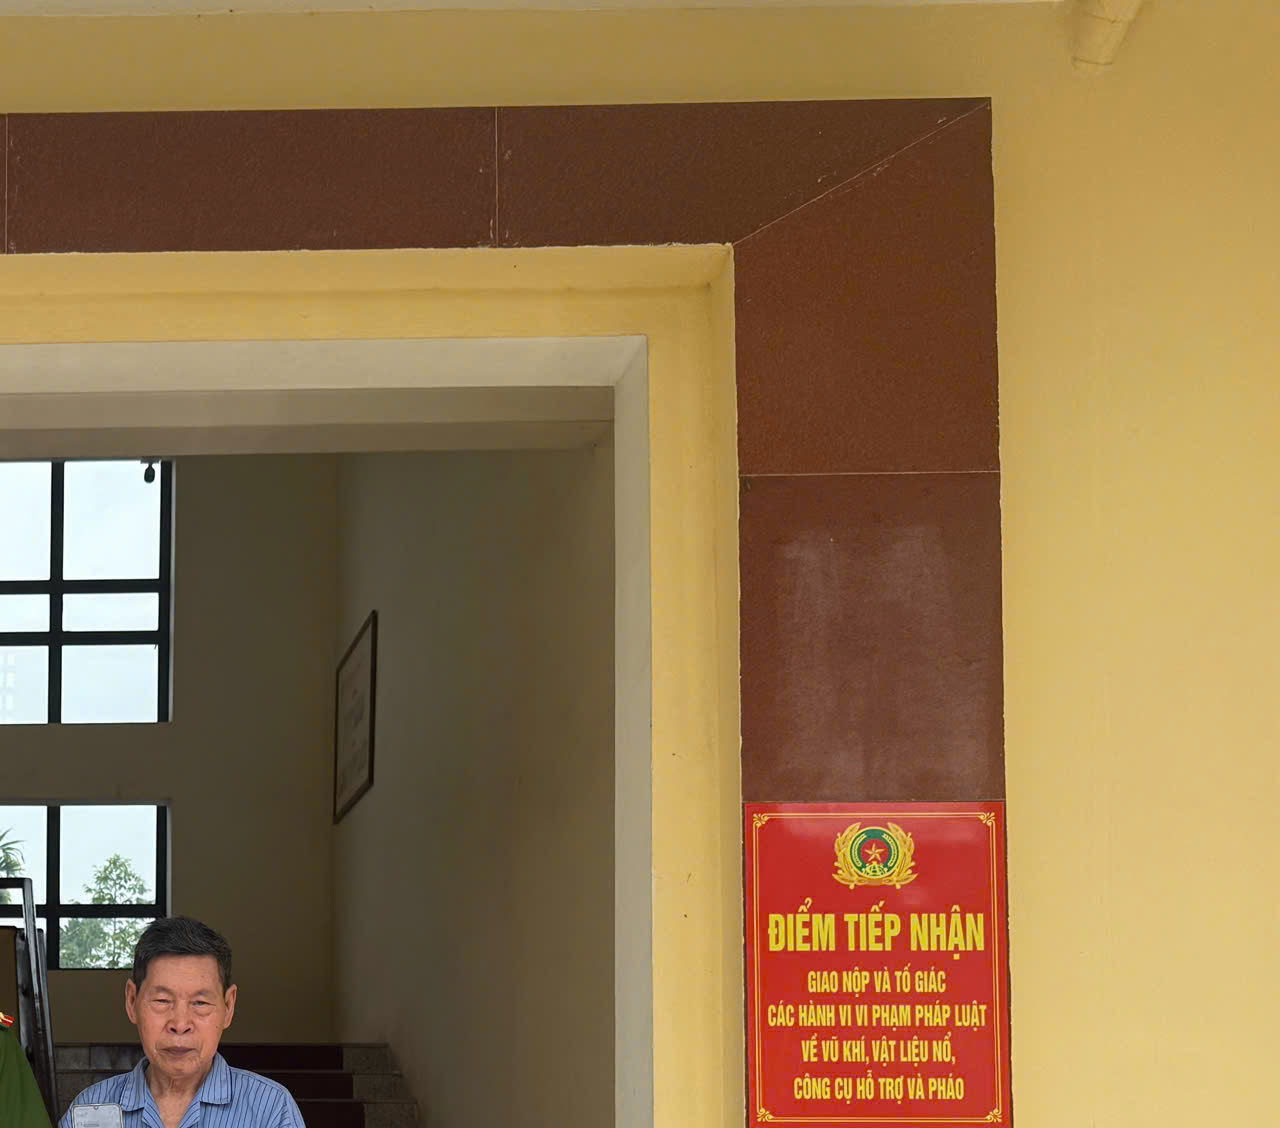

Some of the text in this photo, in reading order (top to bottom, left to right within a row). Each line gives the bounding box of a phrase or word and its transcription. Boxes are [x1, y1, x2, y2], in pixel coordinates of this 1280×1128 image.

[767, 897, 985, 960] ĐIỂM TIẾP NHẬN
[808, 963, 946, 998] GIAO NỘP VÀ TỐ GIÁC
[768, 1000, 986, 1031] CÁC HÀNH VI VI PHẠM PHÁP LUẬT
[821, 1036, 839, 1062] VŨ
[843, 1036, 869, 1065] KHÍ,
[872, 1036, 896, 1067] VẬT
[900, 1036, 928, 1067] LIỆU
[932, 1031, 956, 1065] NỔ,
[794, 1070, 964, 1104] CÔNG CỤ HỖ TRỢ VÀ PHÁO
